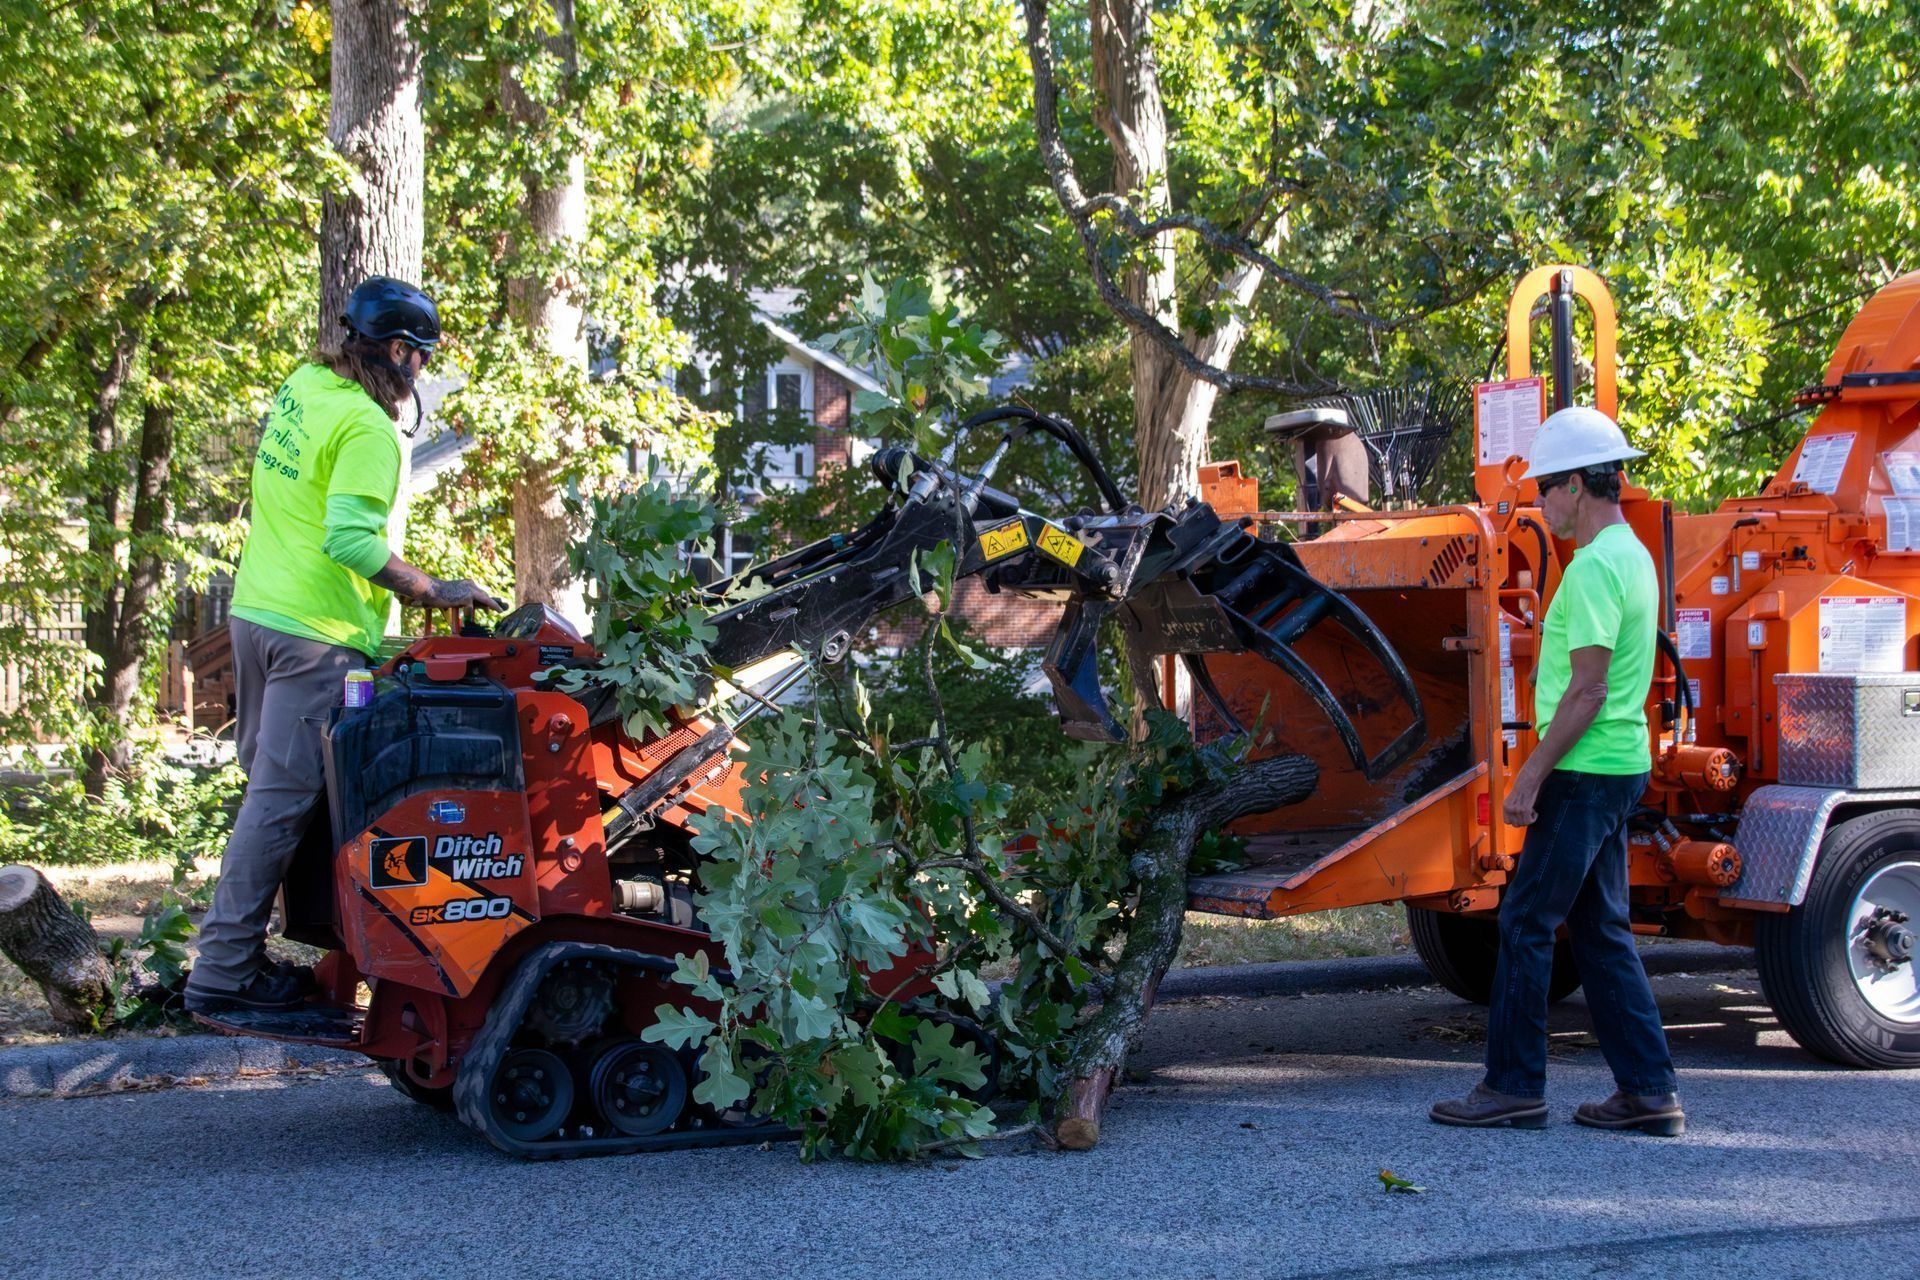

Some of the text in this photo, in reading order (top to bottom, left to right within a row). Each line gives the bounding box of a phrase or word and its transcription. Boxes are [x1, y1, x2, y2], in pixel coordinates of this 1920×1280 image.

[434, 834, 501, 858] Ditch
[453, 857, 521, 879] Witch
[412, 898, 511, 922] SK800
